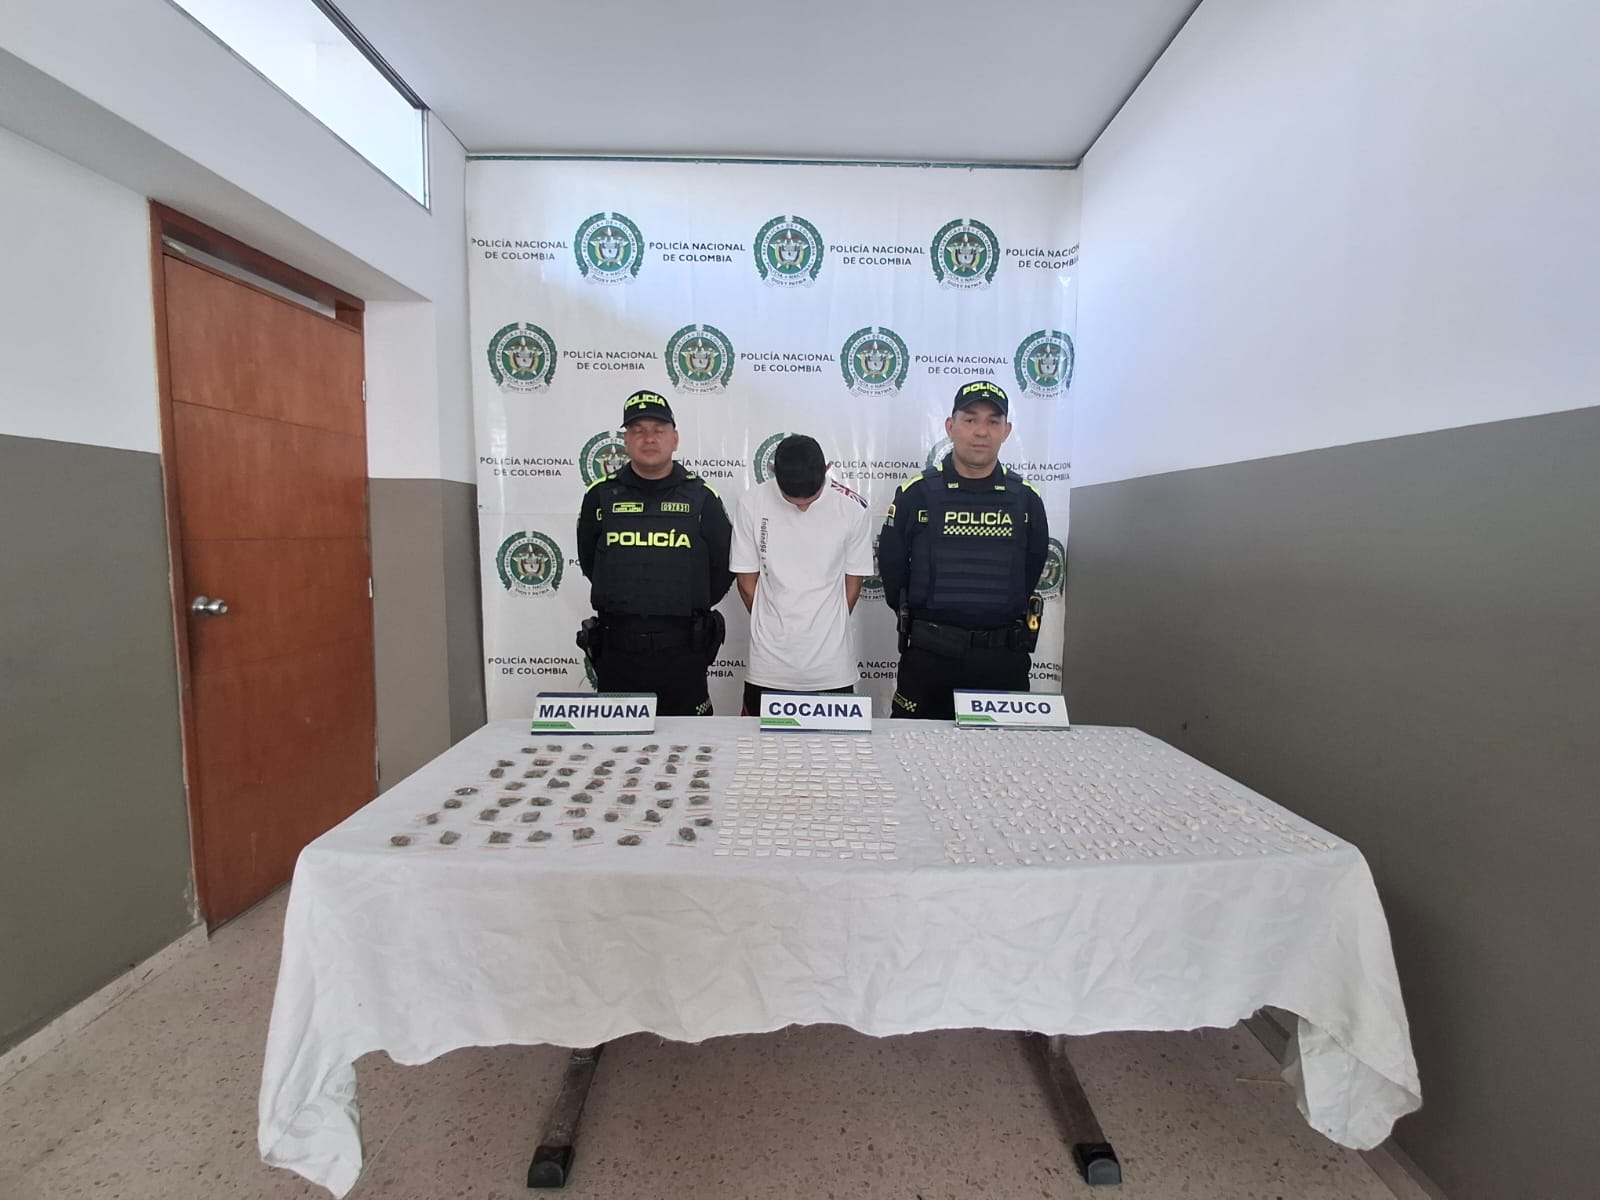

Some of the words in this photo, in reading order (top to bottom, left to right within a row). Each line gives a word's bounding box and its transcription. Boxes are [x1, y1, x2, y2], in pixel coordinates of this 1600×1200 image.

[515, 241, 569, 249] NACIONAL
[692, 243, 745, 251] NACIONAL
[873, 246, 925, 254] NACIONAL
[1048, 243, 1079, 257] NACION
[485, 251, 498, 259] DE
[501, 252, 555, 260] COLOMBIA
[663, 254, 675, 262] DE
[679, 254, 732, 263] COLOMBIA
[843, 257, 855, 265] DE
[859, 257, 912, 265] COLOMBIA
[1018, 260, 1031, 268] DE
[783, 353, 835, 362] NACIONAL
[957, 356, 1008, 364] NACIONAL
[577, 362, 589, 370] DE
[593, 362, 645, 370] COLOMBIA
[754, 364, 766, 372] DE
[769, 364, 822, 373] COLOMBIA
[943, 367, 995, 375] COLOMBIA
[523, 458, 574, 466] NACIONAL
[695, 459, 746, 467] NACIONAL
[494, 468, 507, 477] DE
[510, 468, 562, 477] COLOMBIA
[858, 472, 908, 480] COLOMBIA
[945, 509, 1013, 525] POLICÍA
[606, 528, 691, 548] POLICÍA
[530, 657, 580, 665] NACIONAL
[502, 667, 514, 675] DE
[517, 667, 568, 675] COLOMBIA
[860, 671, 897, 679] OLOMBI
[539, 704, 650, 718] MARIHUANA
[768, 702, 863, 718] COCAINA
[971, 700, 1051, 714] BAZUCO
